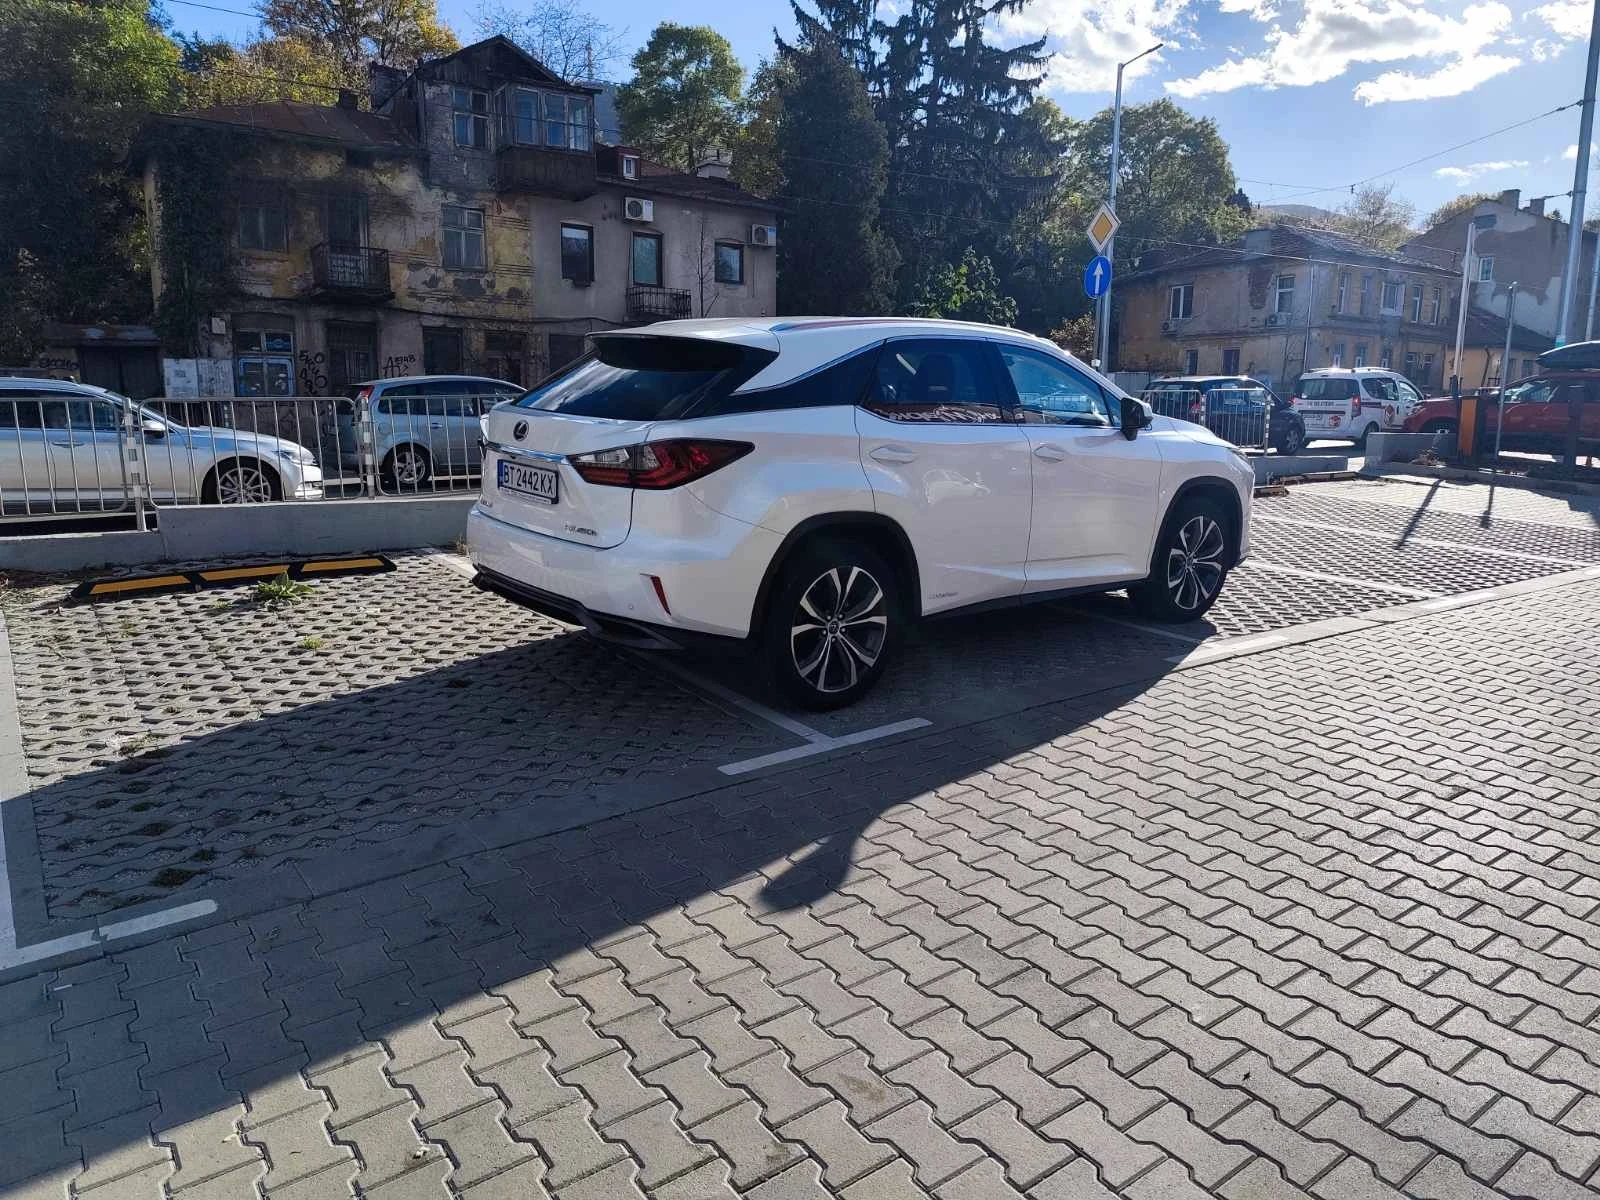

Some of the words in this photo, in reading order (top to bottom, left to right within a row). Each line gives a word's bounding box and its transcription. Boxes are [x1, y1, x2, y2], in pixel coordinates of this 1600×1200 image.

[504, 464, 515, 487] BT
[516, 468, 539, 491] 2442
[540, 473, 554, 494] KX
